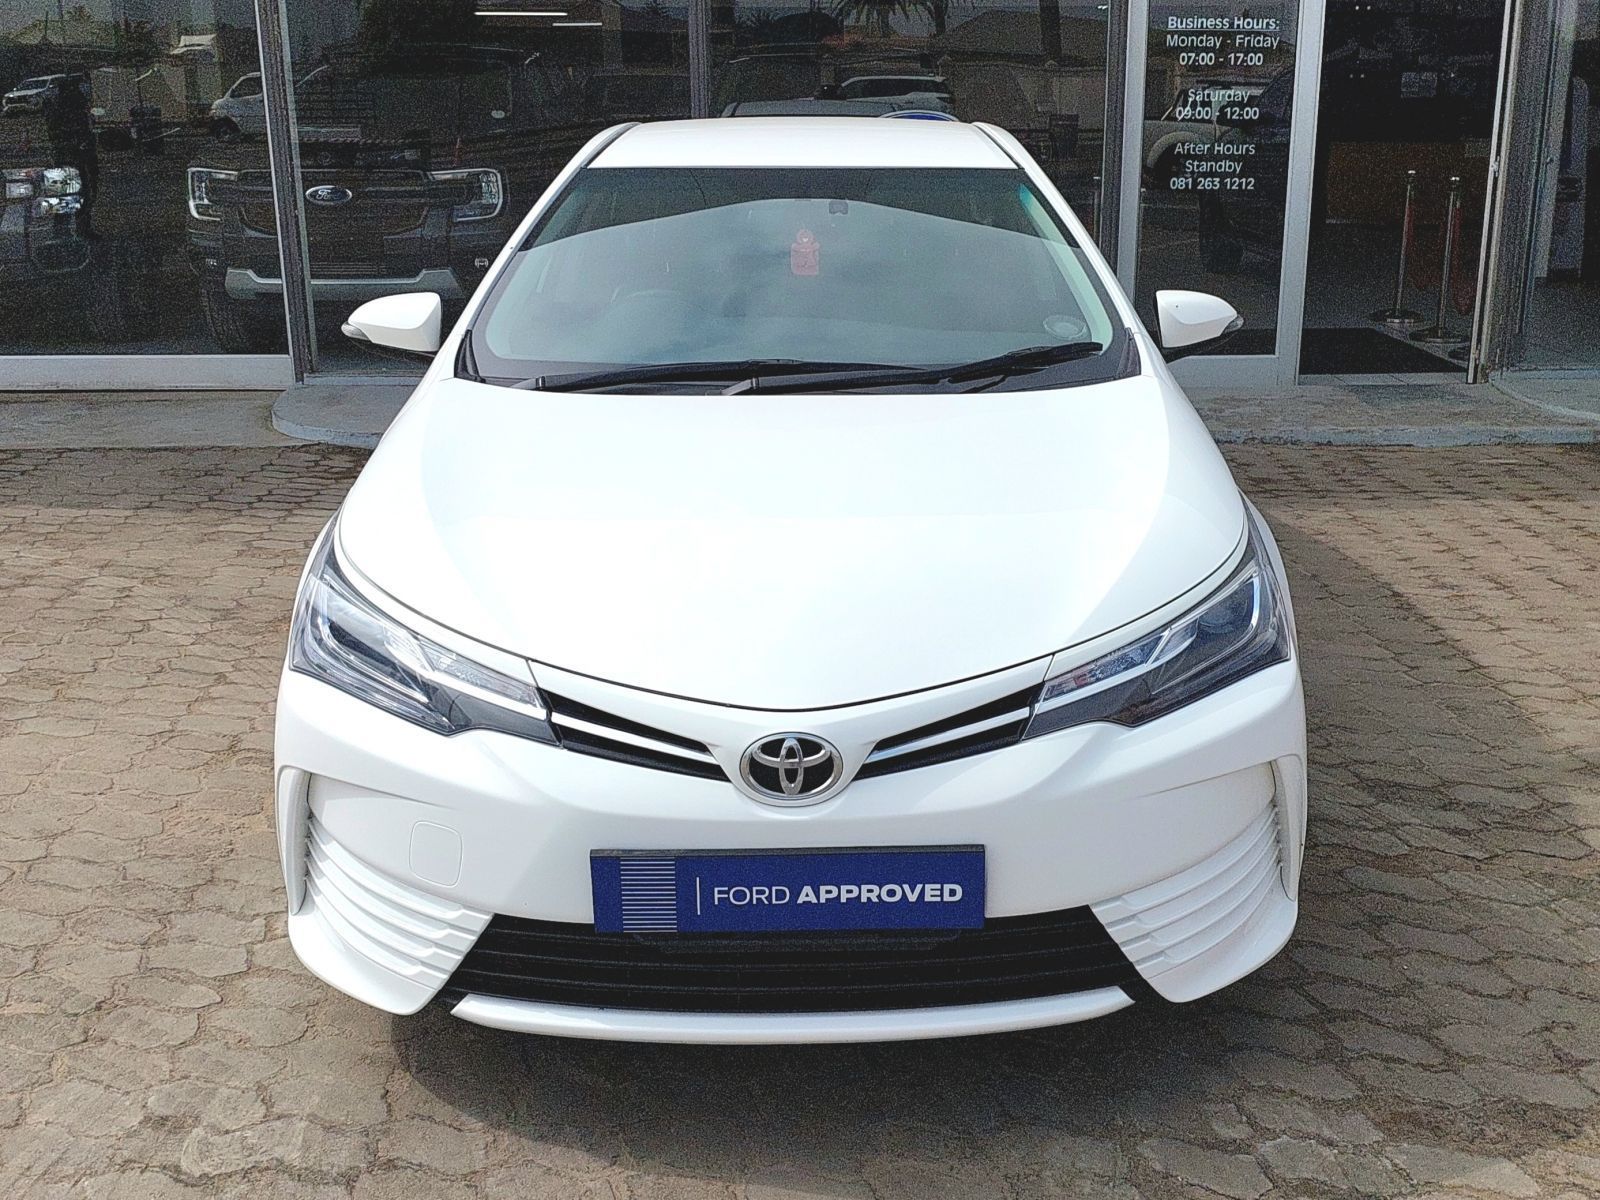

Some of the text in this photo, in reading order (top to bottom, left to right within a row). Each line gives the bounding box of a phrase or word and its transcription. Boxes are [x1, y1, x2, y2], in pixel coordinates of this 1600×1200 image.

[1167, 16, 1280, 30] Business Hours:
[1166, 34, 1222, 49] Monday
[1235, 34, 1280, 49] Friday
[1179, 52, 1215, 66] 07:00
[1227, 52, 1264, 66] 17:00
[1188, 88, 1250, 103] Saturday
[1175, 106, 1212, 120] 09:00
[1224, 106, 1260, 120] 12:00
[1174, 142, 1256, 155] After Hours
[1185, 160, 1243, 174] Standby
[1170, 177, 1256, 190] 081 263 1212
[713, 883, 963, 906] FORD APPROVED
